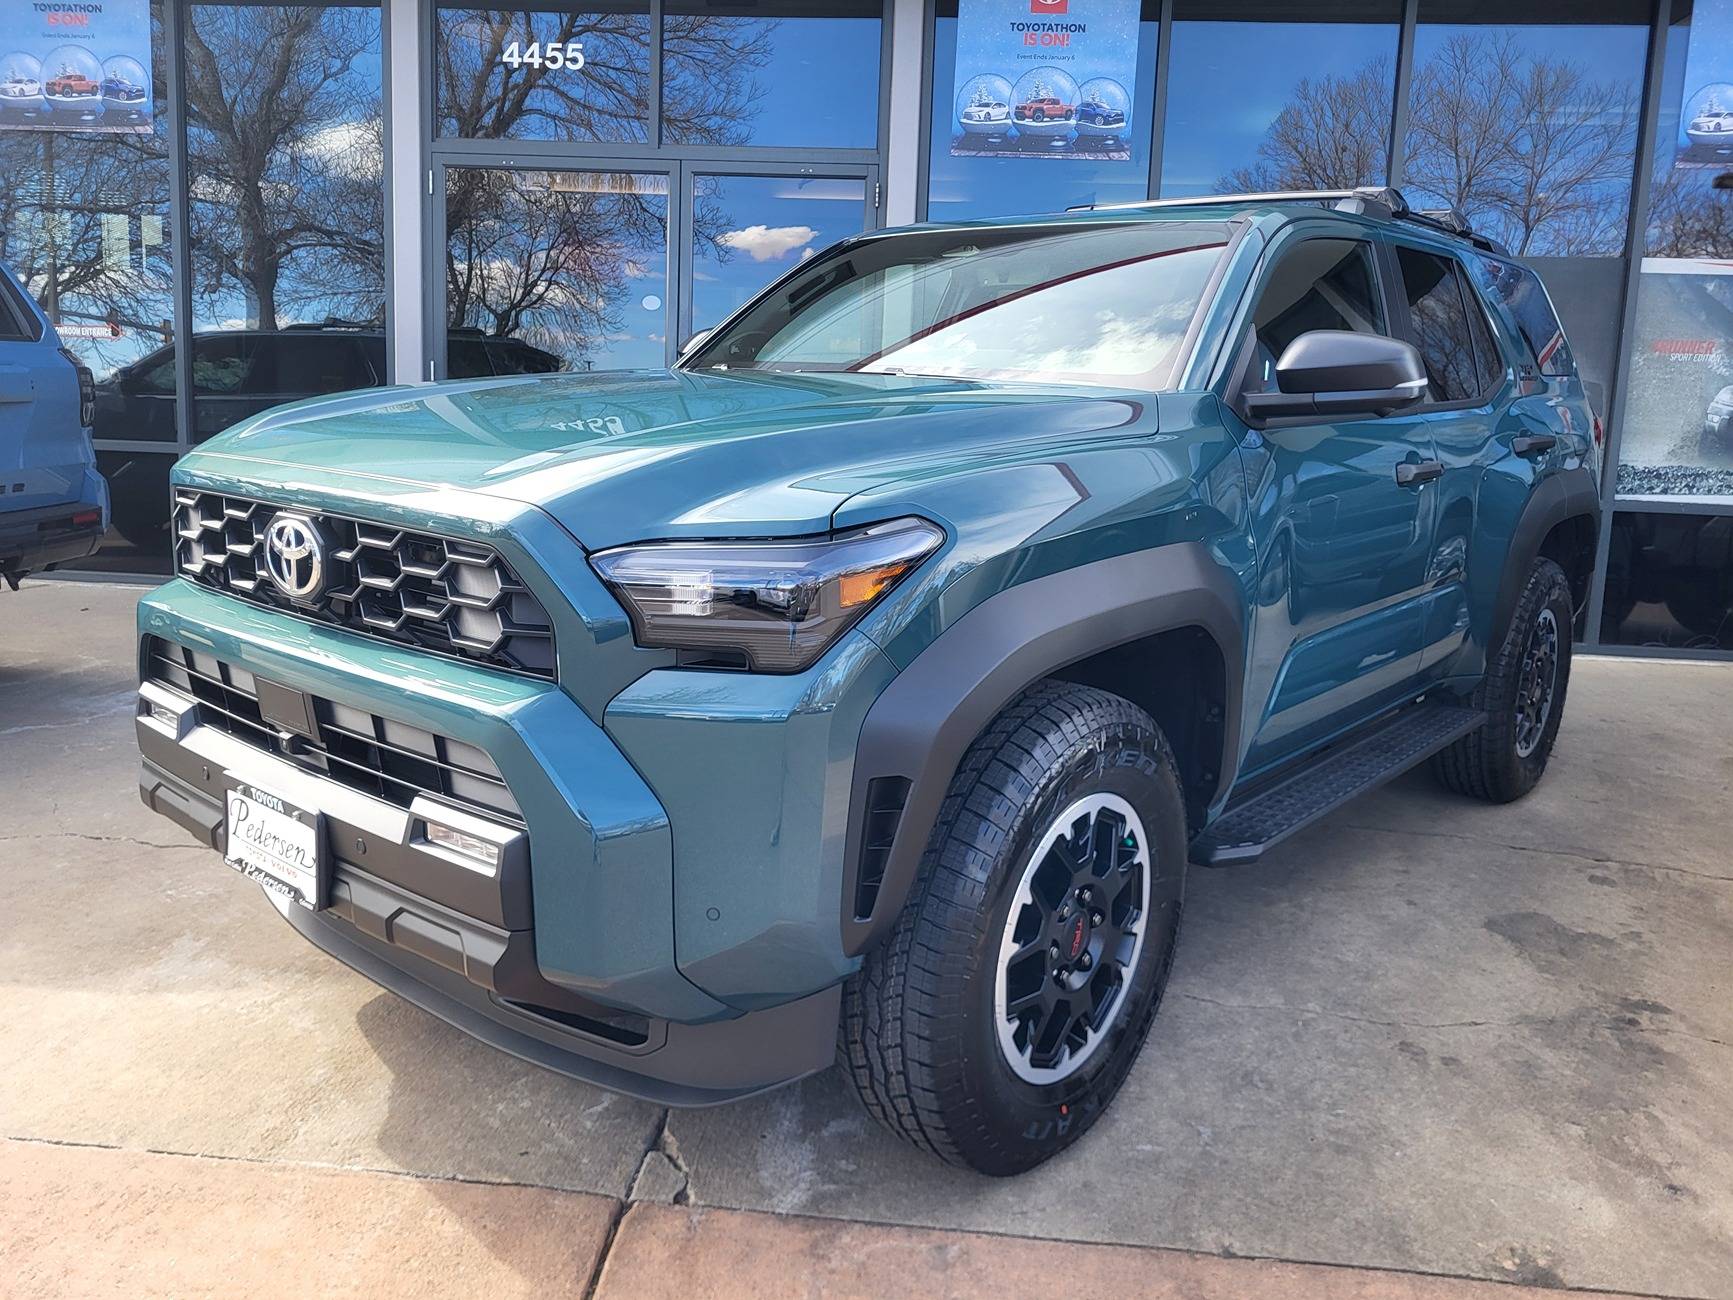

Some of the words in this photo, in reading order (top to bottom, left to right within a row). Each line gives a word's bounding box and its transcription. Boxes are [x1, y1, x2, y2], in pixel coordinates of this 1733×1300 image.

[33, 3, 102, 13] TOYOTATHON
[62, 14, 88, 27] ON!
[1010, 22, 1086, 33] TOYOTATHON
[1024, 33, 1037, 46] IS
[1040, 33, 1070, 47] ON!
[502, 42, 585, 70] 4455
[55, 327, 80, 336] OWROOM
[81, 327, 112, 336] ENTRANCE
[1670, 353, 1691, 362] SPORT
[250, 788, 284, 813] TOYOTA
[230, 798, 315, 868] Pedersen
